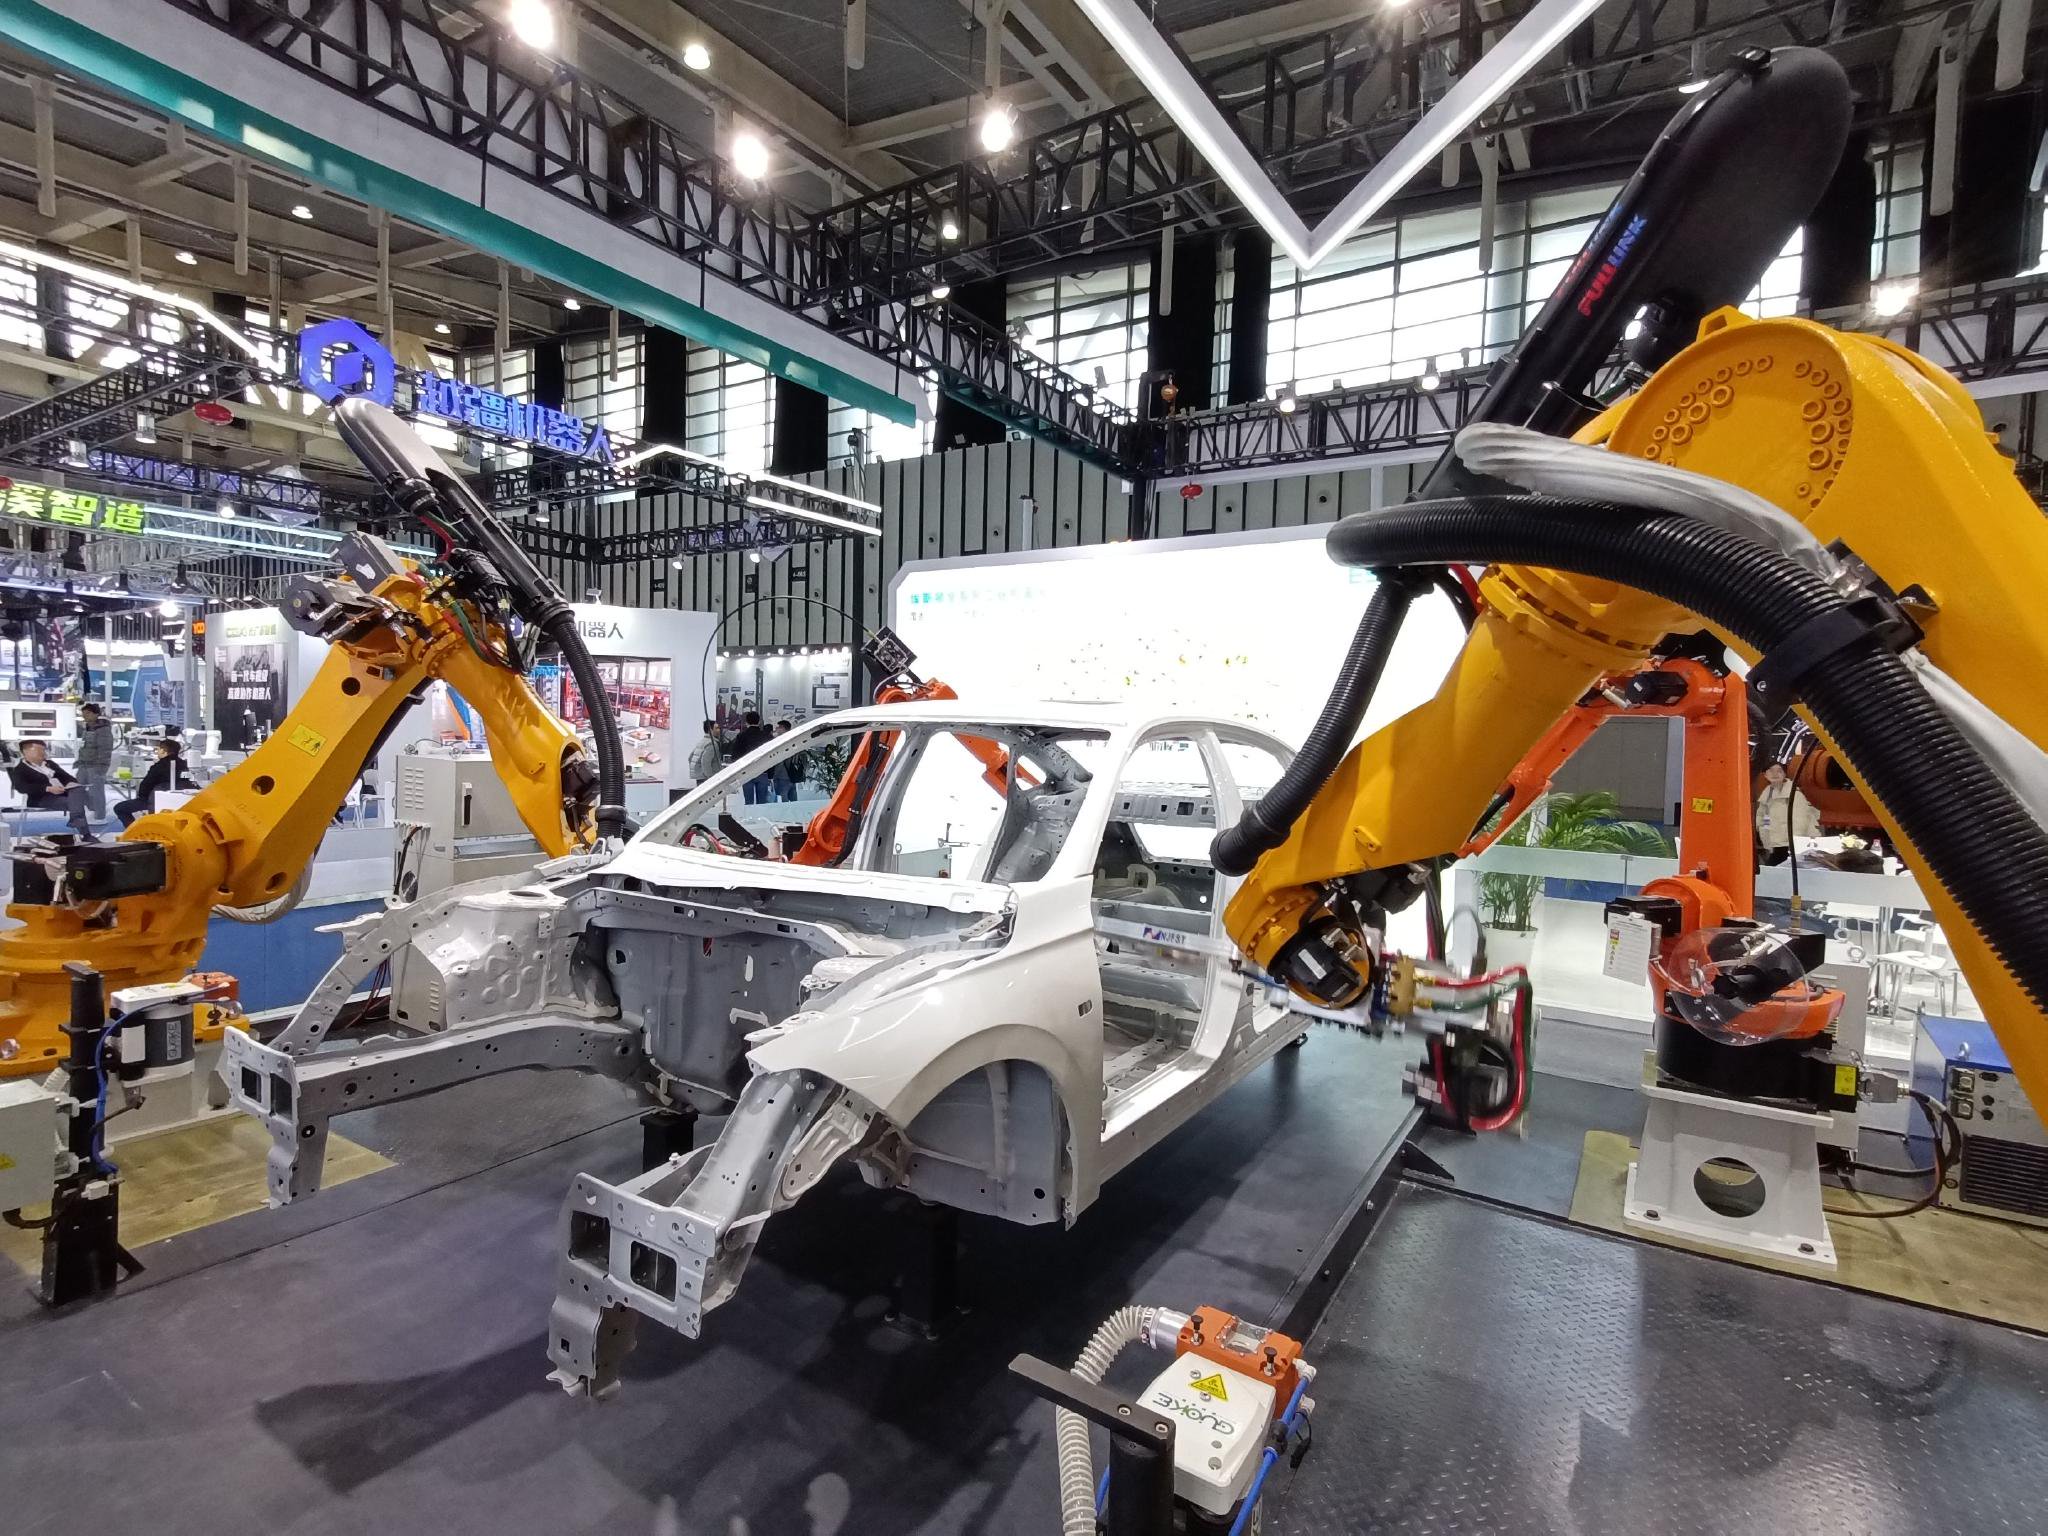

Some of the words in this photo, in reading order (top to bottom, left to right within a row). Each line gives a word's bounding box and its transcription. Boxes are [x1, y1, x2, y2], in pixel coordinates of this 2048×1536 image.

[418, 370, 616, 465] 越疆机器人
